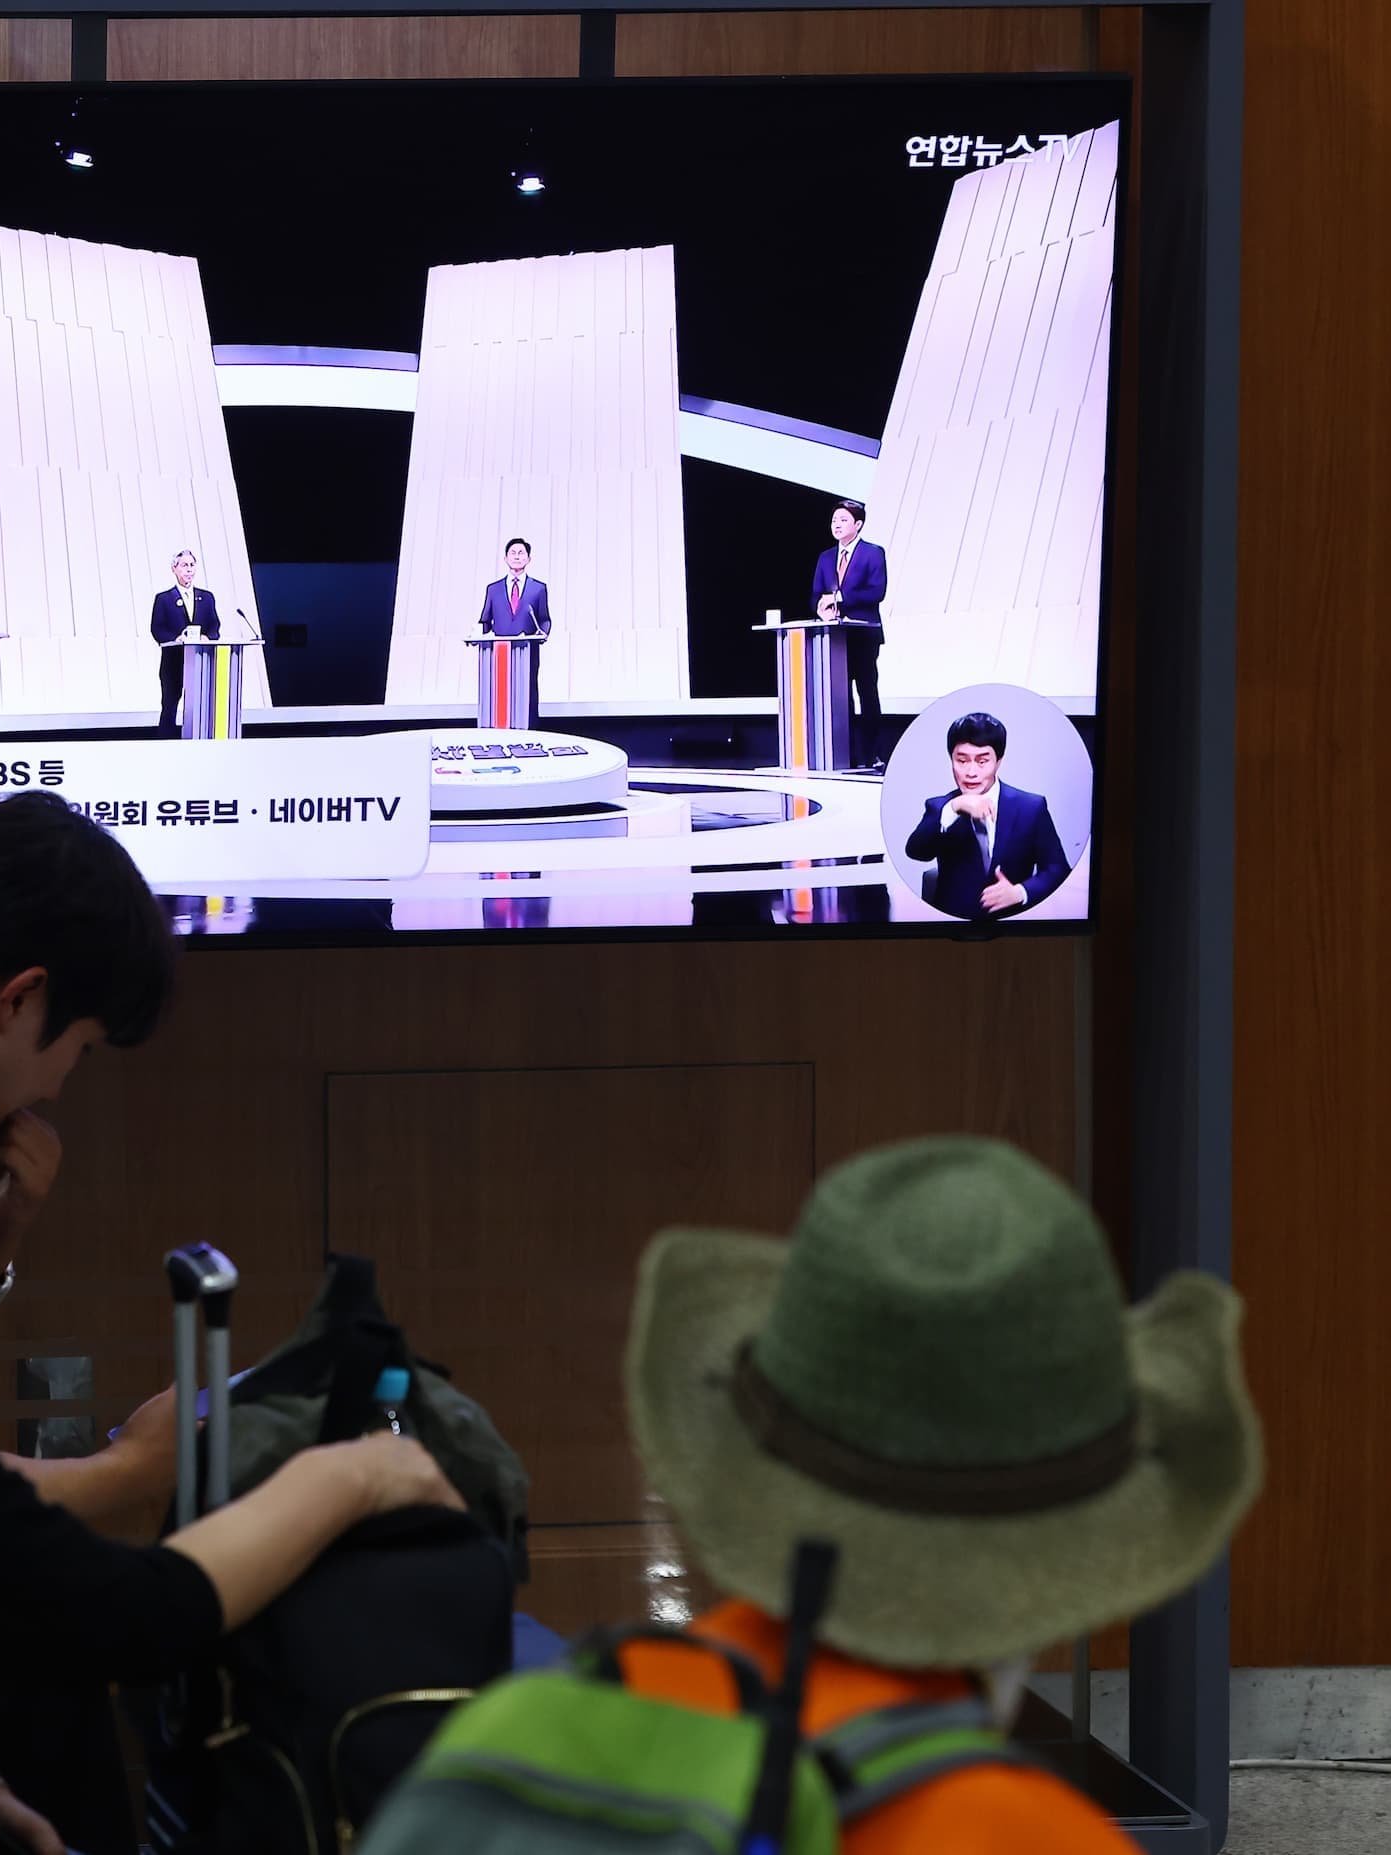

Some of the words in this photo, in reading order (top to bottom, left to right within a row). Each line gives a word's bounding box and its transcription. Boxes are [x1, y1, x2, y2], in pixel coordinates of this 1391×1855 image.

[905, 134, 1084, 168] 연합뉴스TV
[38, 759, 65, 785] 등
[155, 799, 240, 827] 유튜브
[269, 796, 401, 824] 네이버TV
